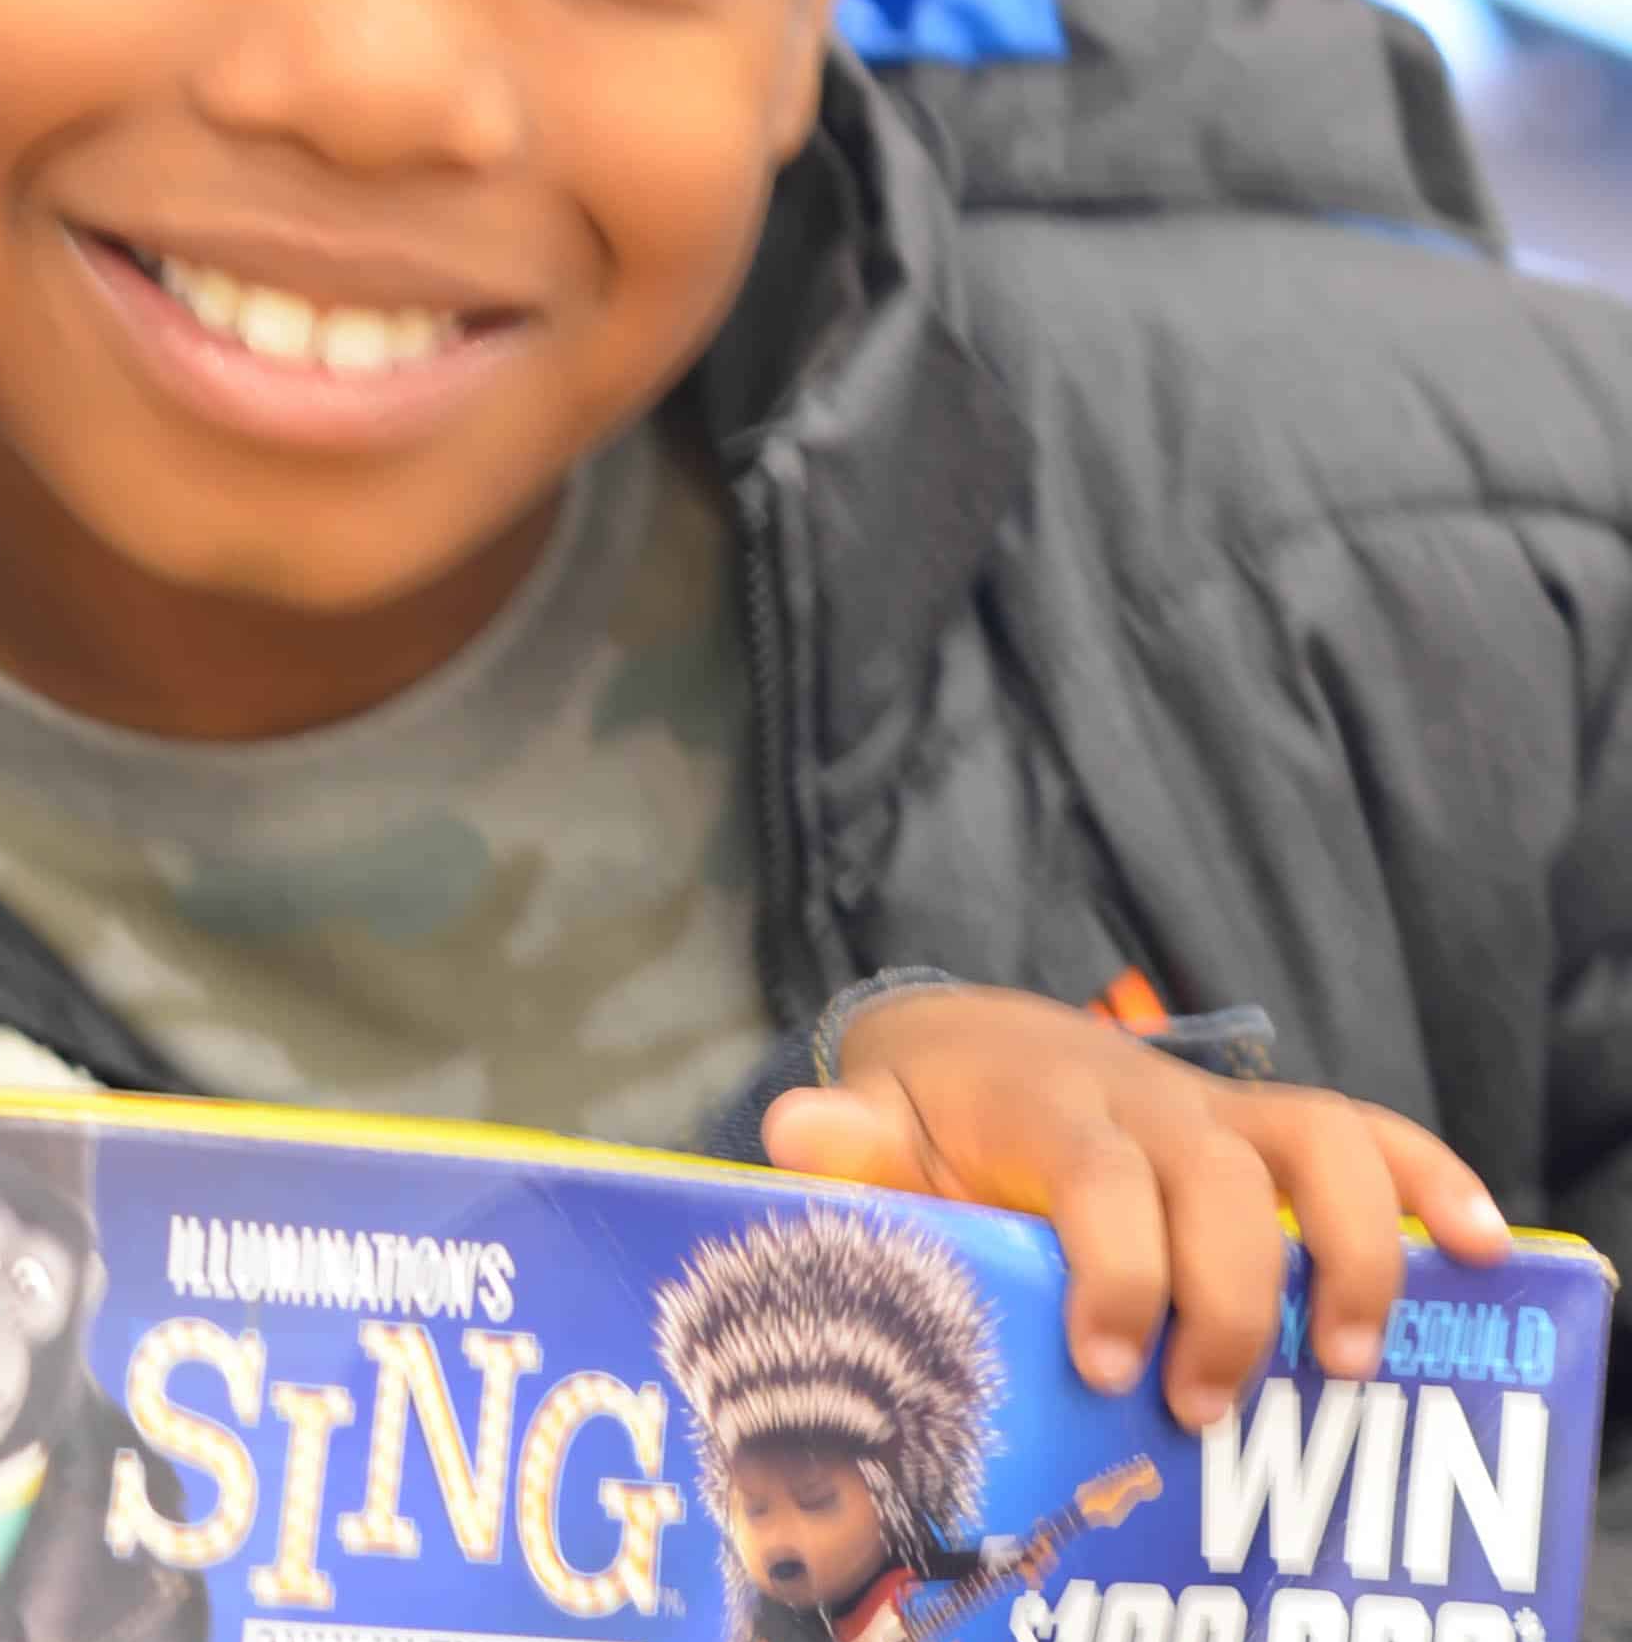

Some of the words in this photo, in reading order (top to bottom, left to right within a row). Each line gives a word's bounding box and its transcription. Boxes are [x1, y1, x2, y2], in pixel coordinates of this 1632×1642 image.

[1383, 1297, 1558, 1386] COULD
[105, 1314, 687, 1618] SING
[1200, 1375, 1549, 1594] WIN
